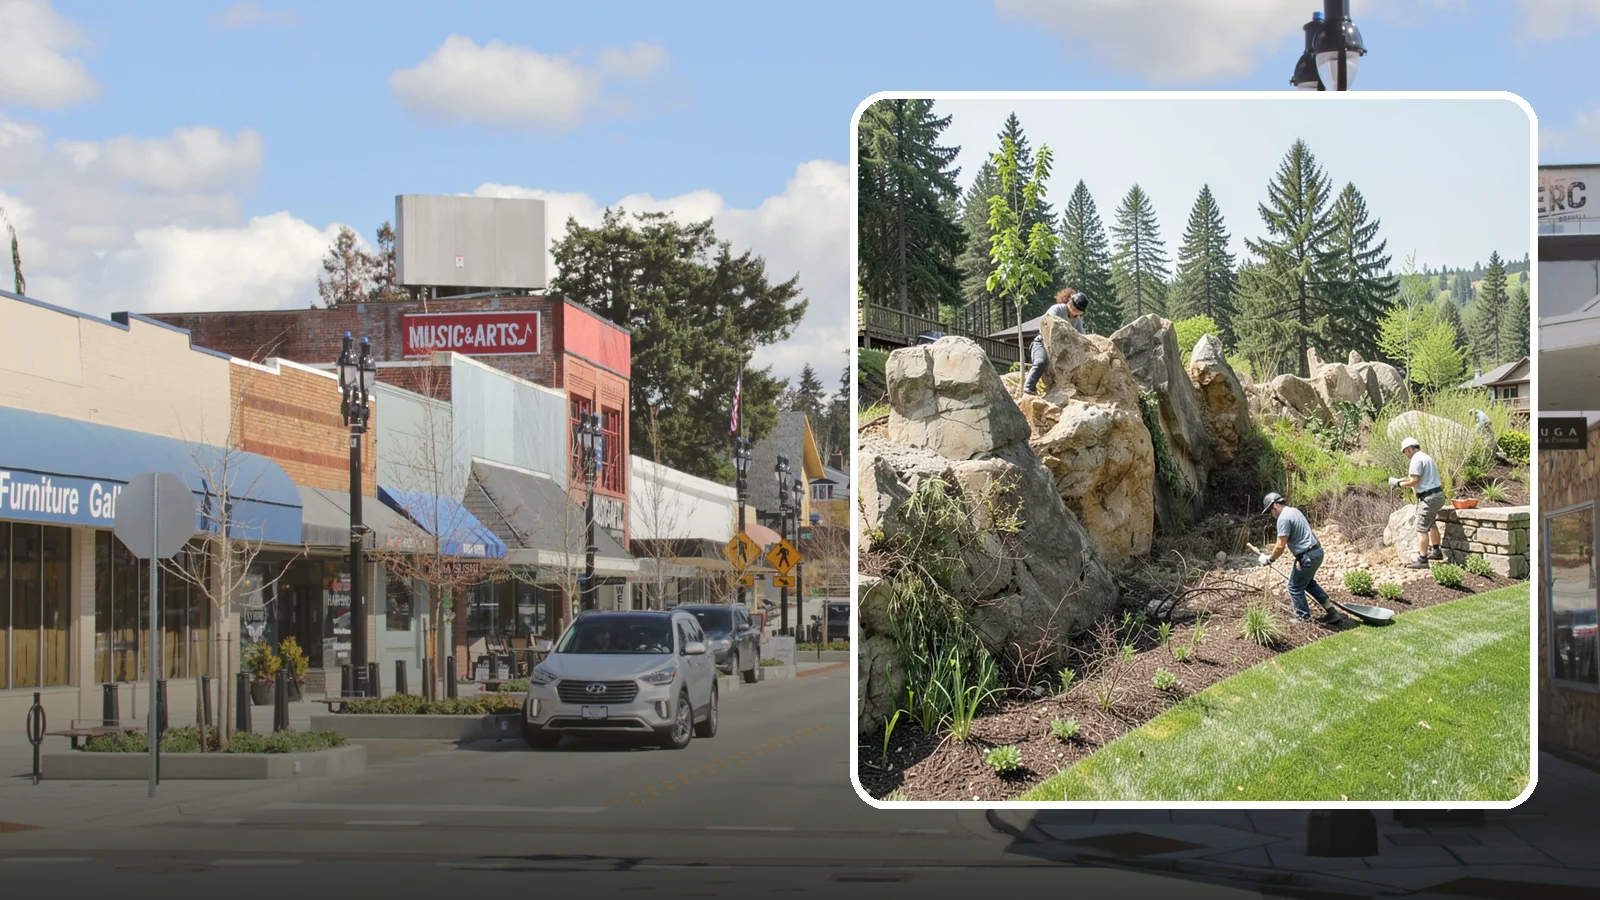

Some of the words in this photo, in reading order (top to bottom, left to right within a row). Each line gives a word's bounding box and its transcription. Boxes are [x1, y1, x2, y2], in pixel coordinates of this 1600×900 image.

[0, 471, 80, 515] Furniture
[89, 482, 122, 519] Gal
[453, 563, 479, 574] SUSHI
